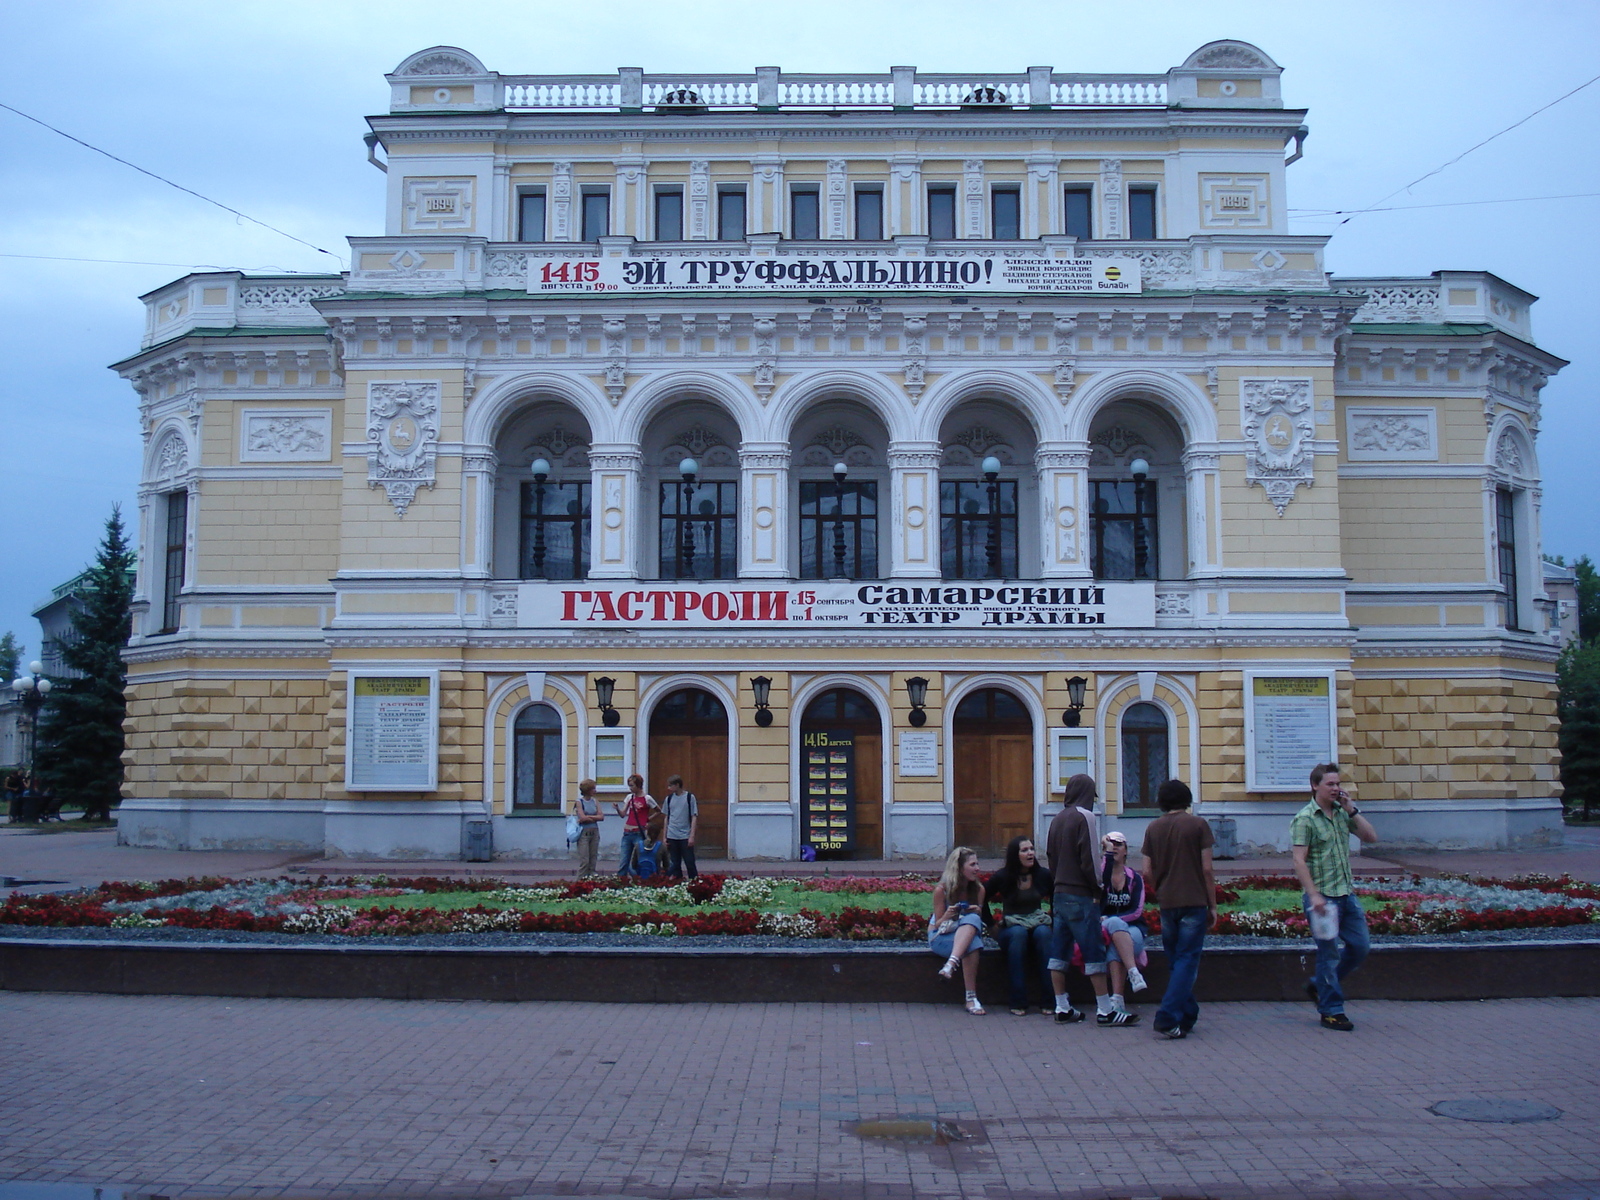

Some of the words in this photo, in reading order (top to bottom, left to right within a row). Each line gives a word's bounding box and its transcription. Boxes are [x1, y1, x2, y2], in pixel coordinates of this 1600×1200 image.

[427, 199, 455, 211] 1894
[1221, 196, 1249, 208] 1896
[540, 262, 600, 283] 14,15
[622, 258, 673, 285] ЭЙ,
[680, 259, 993, 284] ТРУФФАЛЬДИНО!
[560, 590, 789, 621] ГАСТРОЛИ
[797, 591, 816, 605] 15
[804, 606, 813, 621] 1
[859, 611, 961, 624] ТЕАТР
[981, 611, 1106, 626] ДРАМЫ
